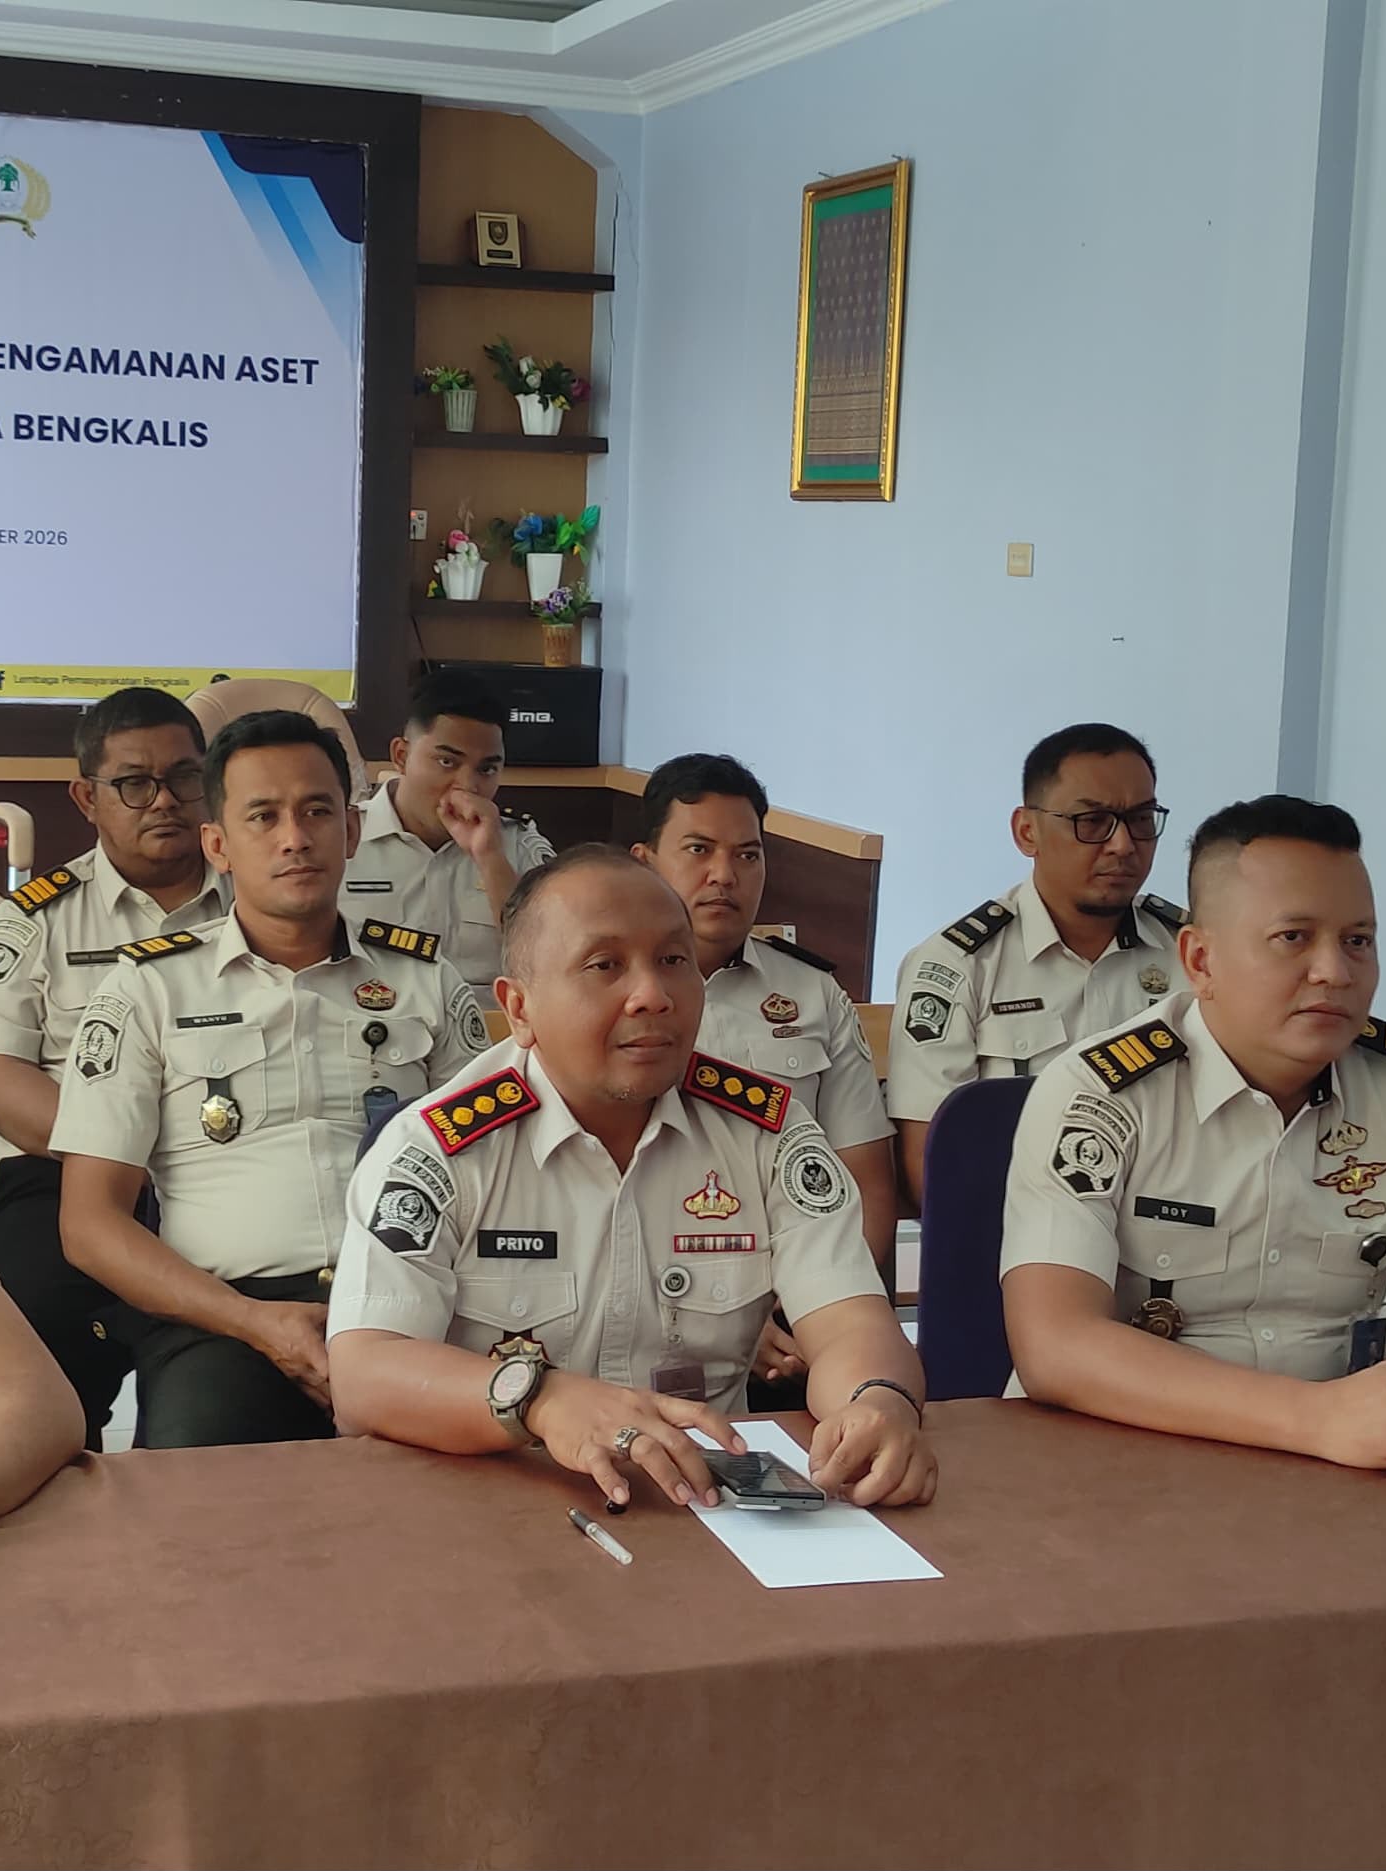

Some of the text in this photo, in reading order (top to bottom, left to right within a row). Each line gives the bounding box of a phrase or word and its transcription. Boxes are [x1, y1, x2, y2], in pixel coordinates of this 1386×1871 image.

[235, 356, 320, 385] ASET
[14, 414, 209, 448] BENGKALIS
[24, 529, 68, 546] 2026
[1086, 1050, 1123, 1084] IMIPAS
[764, 1086, 785, 1124] IMIPAS
[427, 1106, 462, 1146] IMIPAS
[495, 1237, 544, 1251] PRIYO
